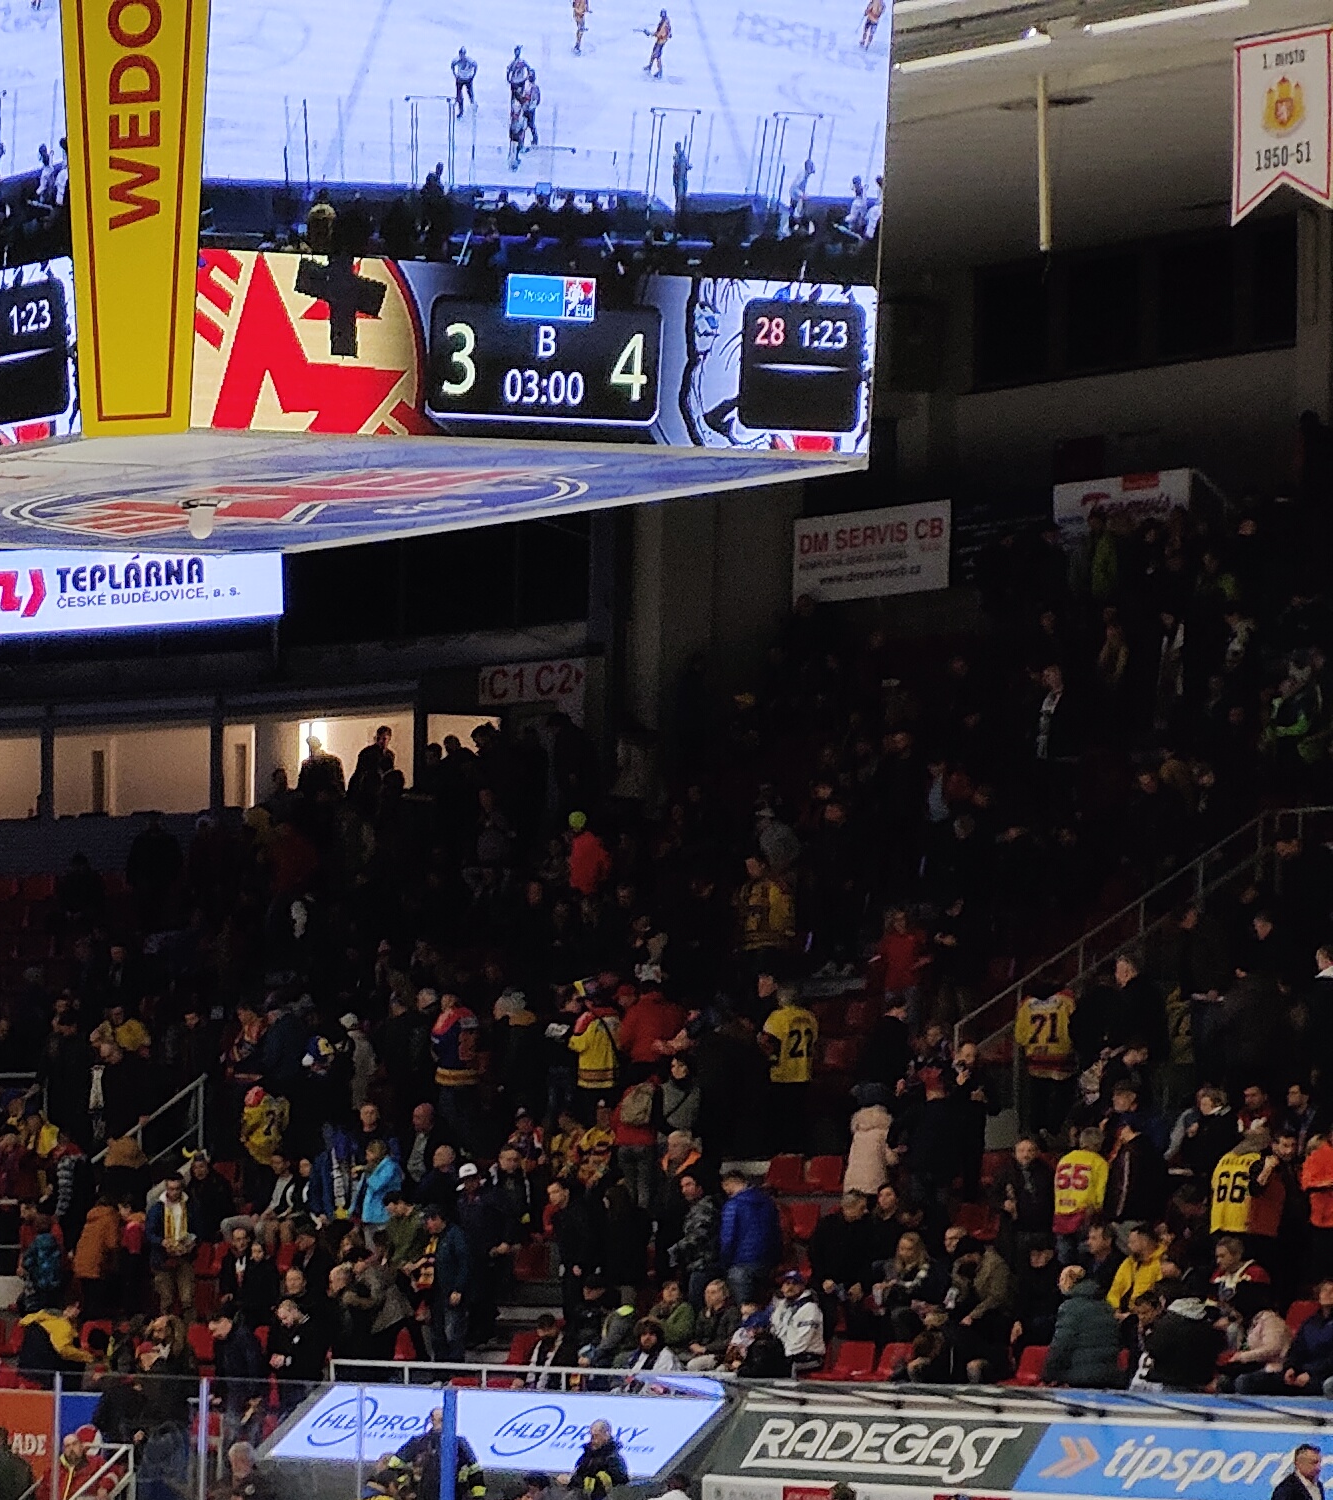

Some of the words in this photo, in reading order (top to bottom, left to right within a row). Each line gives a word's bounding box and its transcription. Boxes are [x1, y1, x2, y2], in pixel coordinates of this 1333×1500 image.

[1255, 140, 1312, 172] 1950-51
[10, 299, 52, 335] 1:23
[754, 316, 786, 347] 28
[798, 319, 849, 349] 1:23
[441, 322, 476, 395] 3
[537, 325, 557, 358] B
[610, 333, 648, 402] 4
[503, 368, 585, 405] 03:00
[835, 521, 908, 551] SERVIS
[914, 517, 944, 540] CB
[56, 556, 206, 592] TEPLÁRNA
[56, 589, 107, 609] ČESKÉ
[534, 662, 574, 697] C2
[496, 1421, 554, 1439] HLB
[740, 1416, 1024, 1485] RADEGAST
